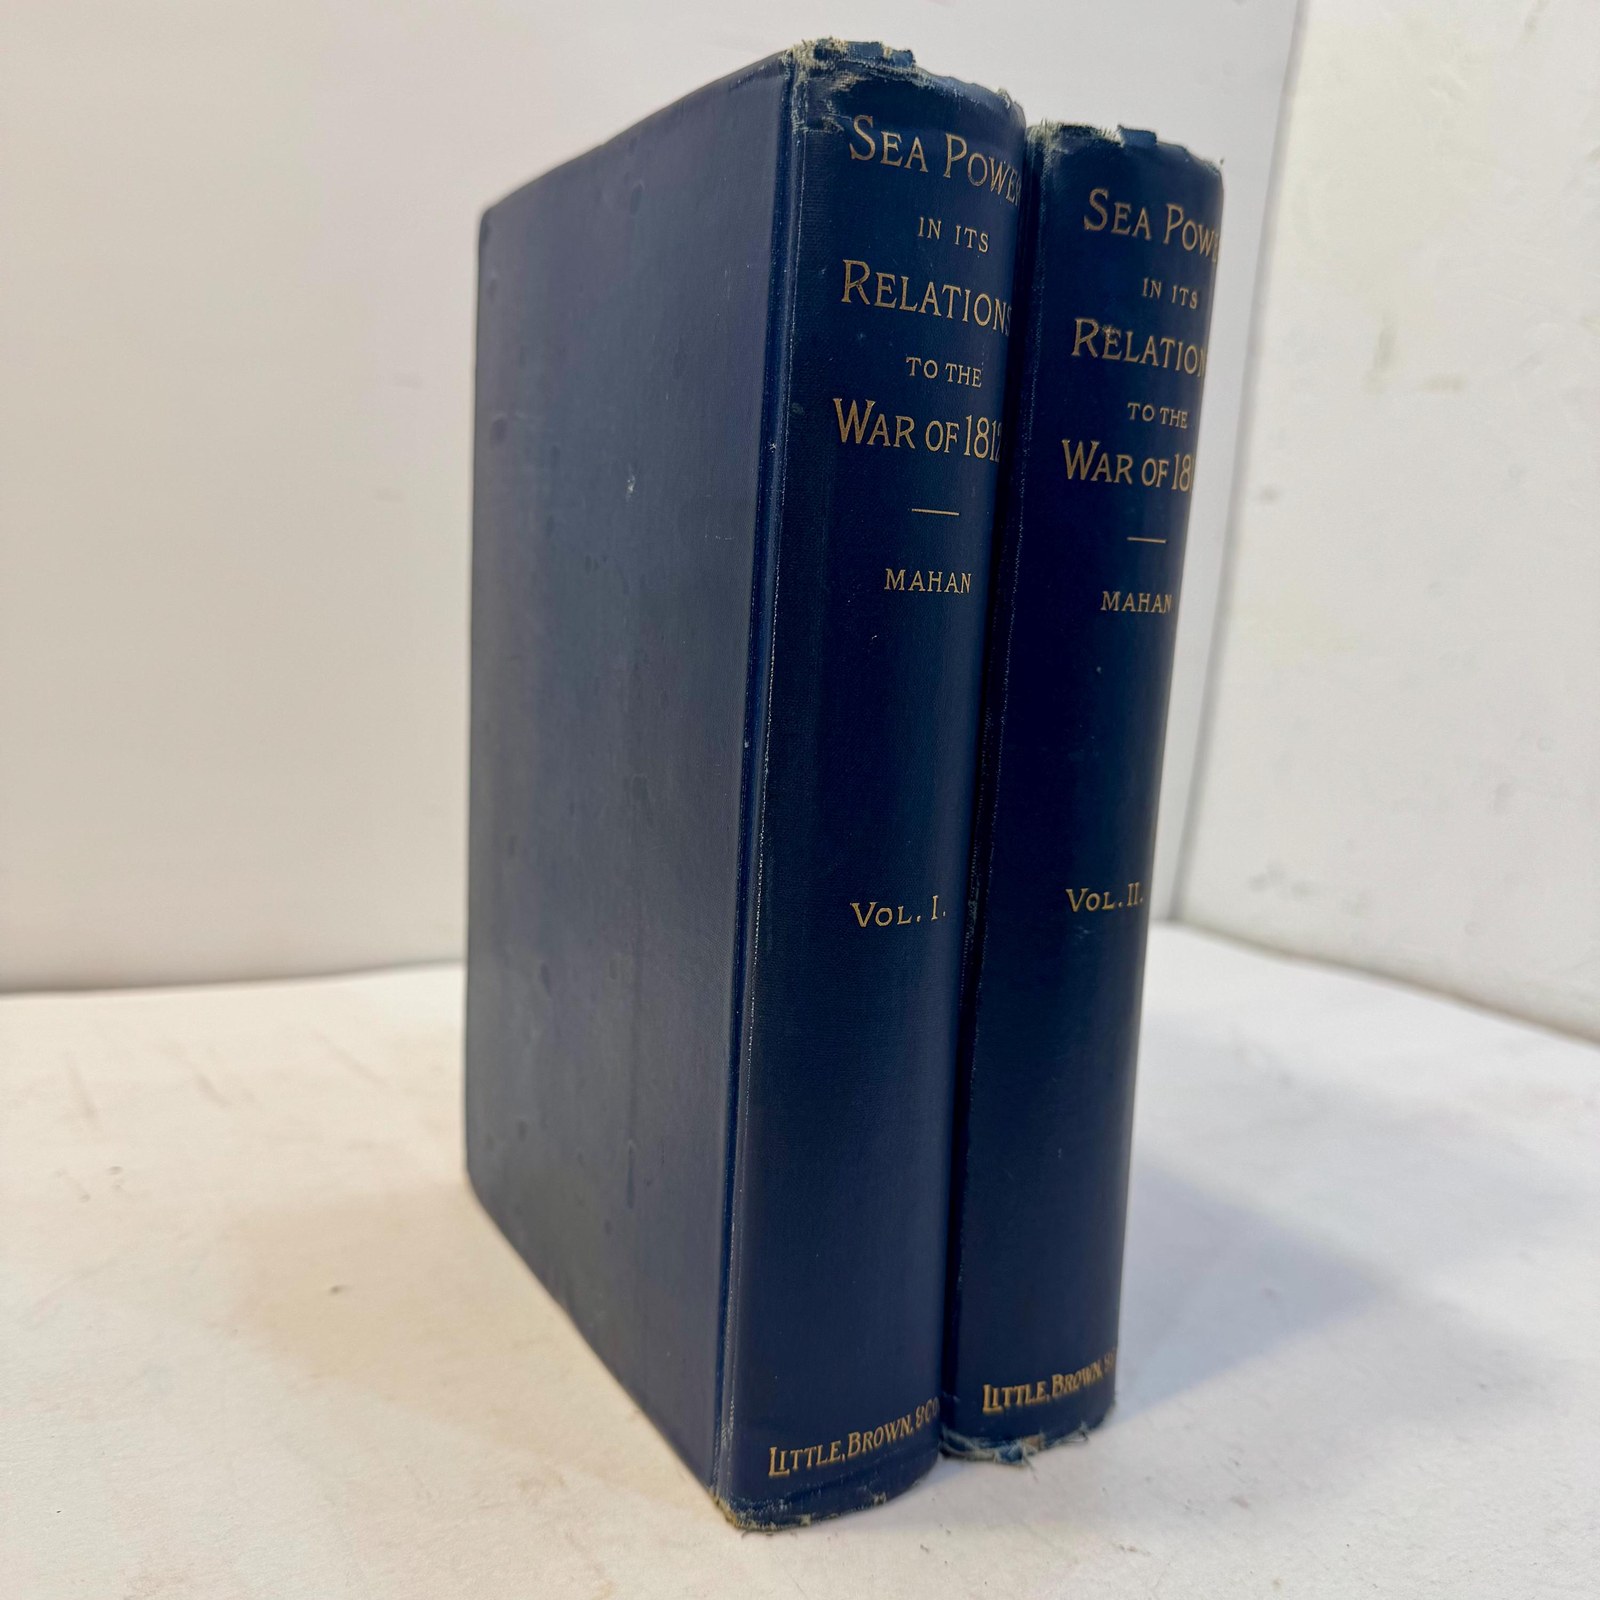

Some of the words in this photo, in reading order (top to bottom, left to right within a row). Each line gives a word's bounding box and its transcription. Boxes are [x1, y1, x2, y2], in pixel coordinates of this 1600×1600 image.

[850, 115, 928, 173] SEA
[1084, 187, 1152, 241] SEA
[918, 216, 942, 239] IN
[955, 225, 989, 252] ITS
[1142, 277, 1162, 299] IN
[1172, 285, 1198, 309] ITS
[906, 356, 939, 379] TO
[945, 362, 982, 388] THE
[833, 398, 915, 449] WAR
[925, 420, 960, 453] OF
[1127, 402, 1155, 421] TO
[1160, 407, 1188, 429] THE
[1061, 439, 1133, 485] WAR
[1141, 457, 1169, 487] OF
[884, 568, 972, 594] MAHAN
[1100, 591, 1172, 613] MAHAN
[851, 901, 921, 927] VOL.
[931, 895, 947, 920] I.
[1066, 887, 1122, 912] VOL.
